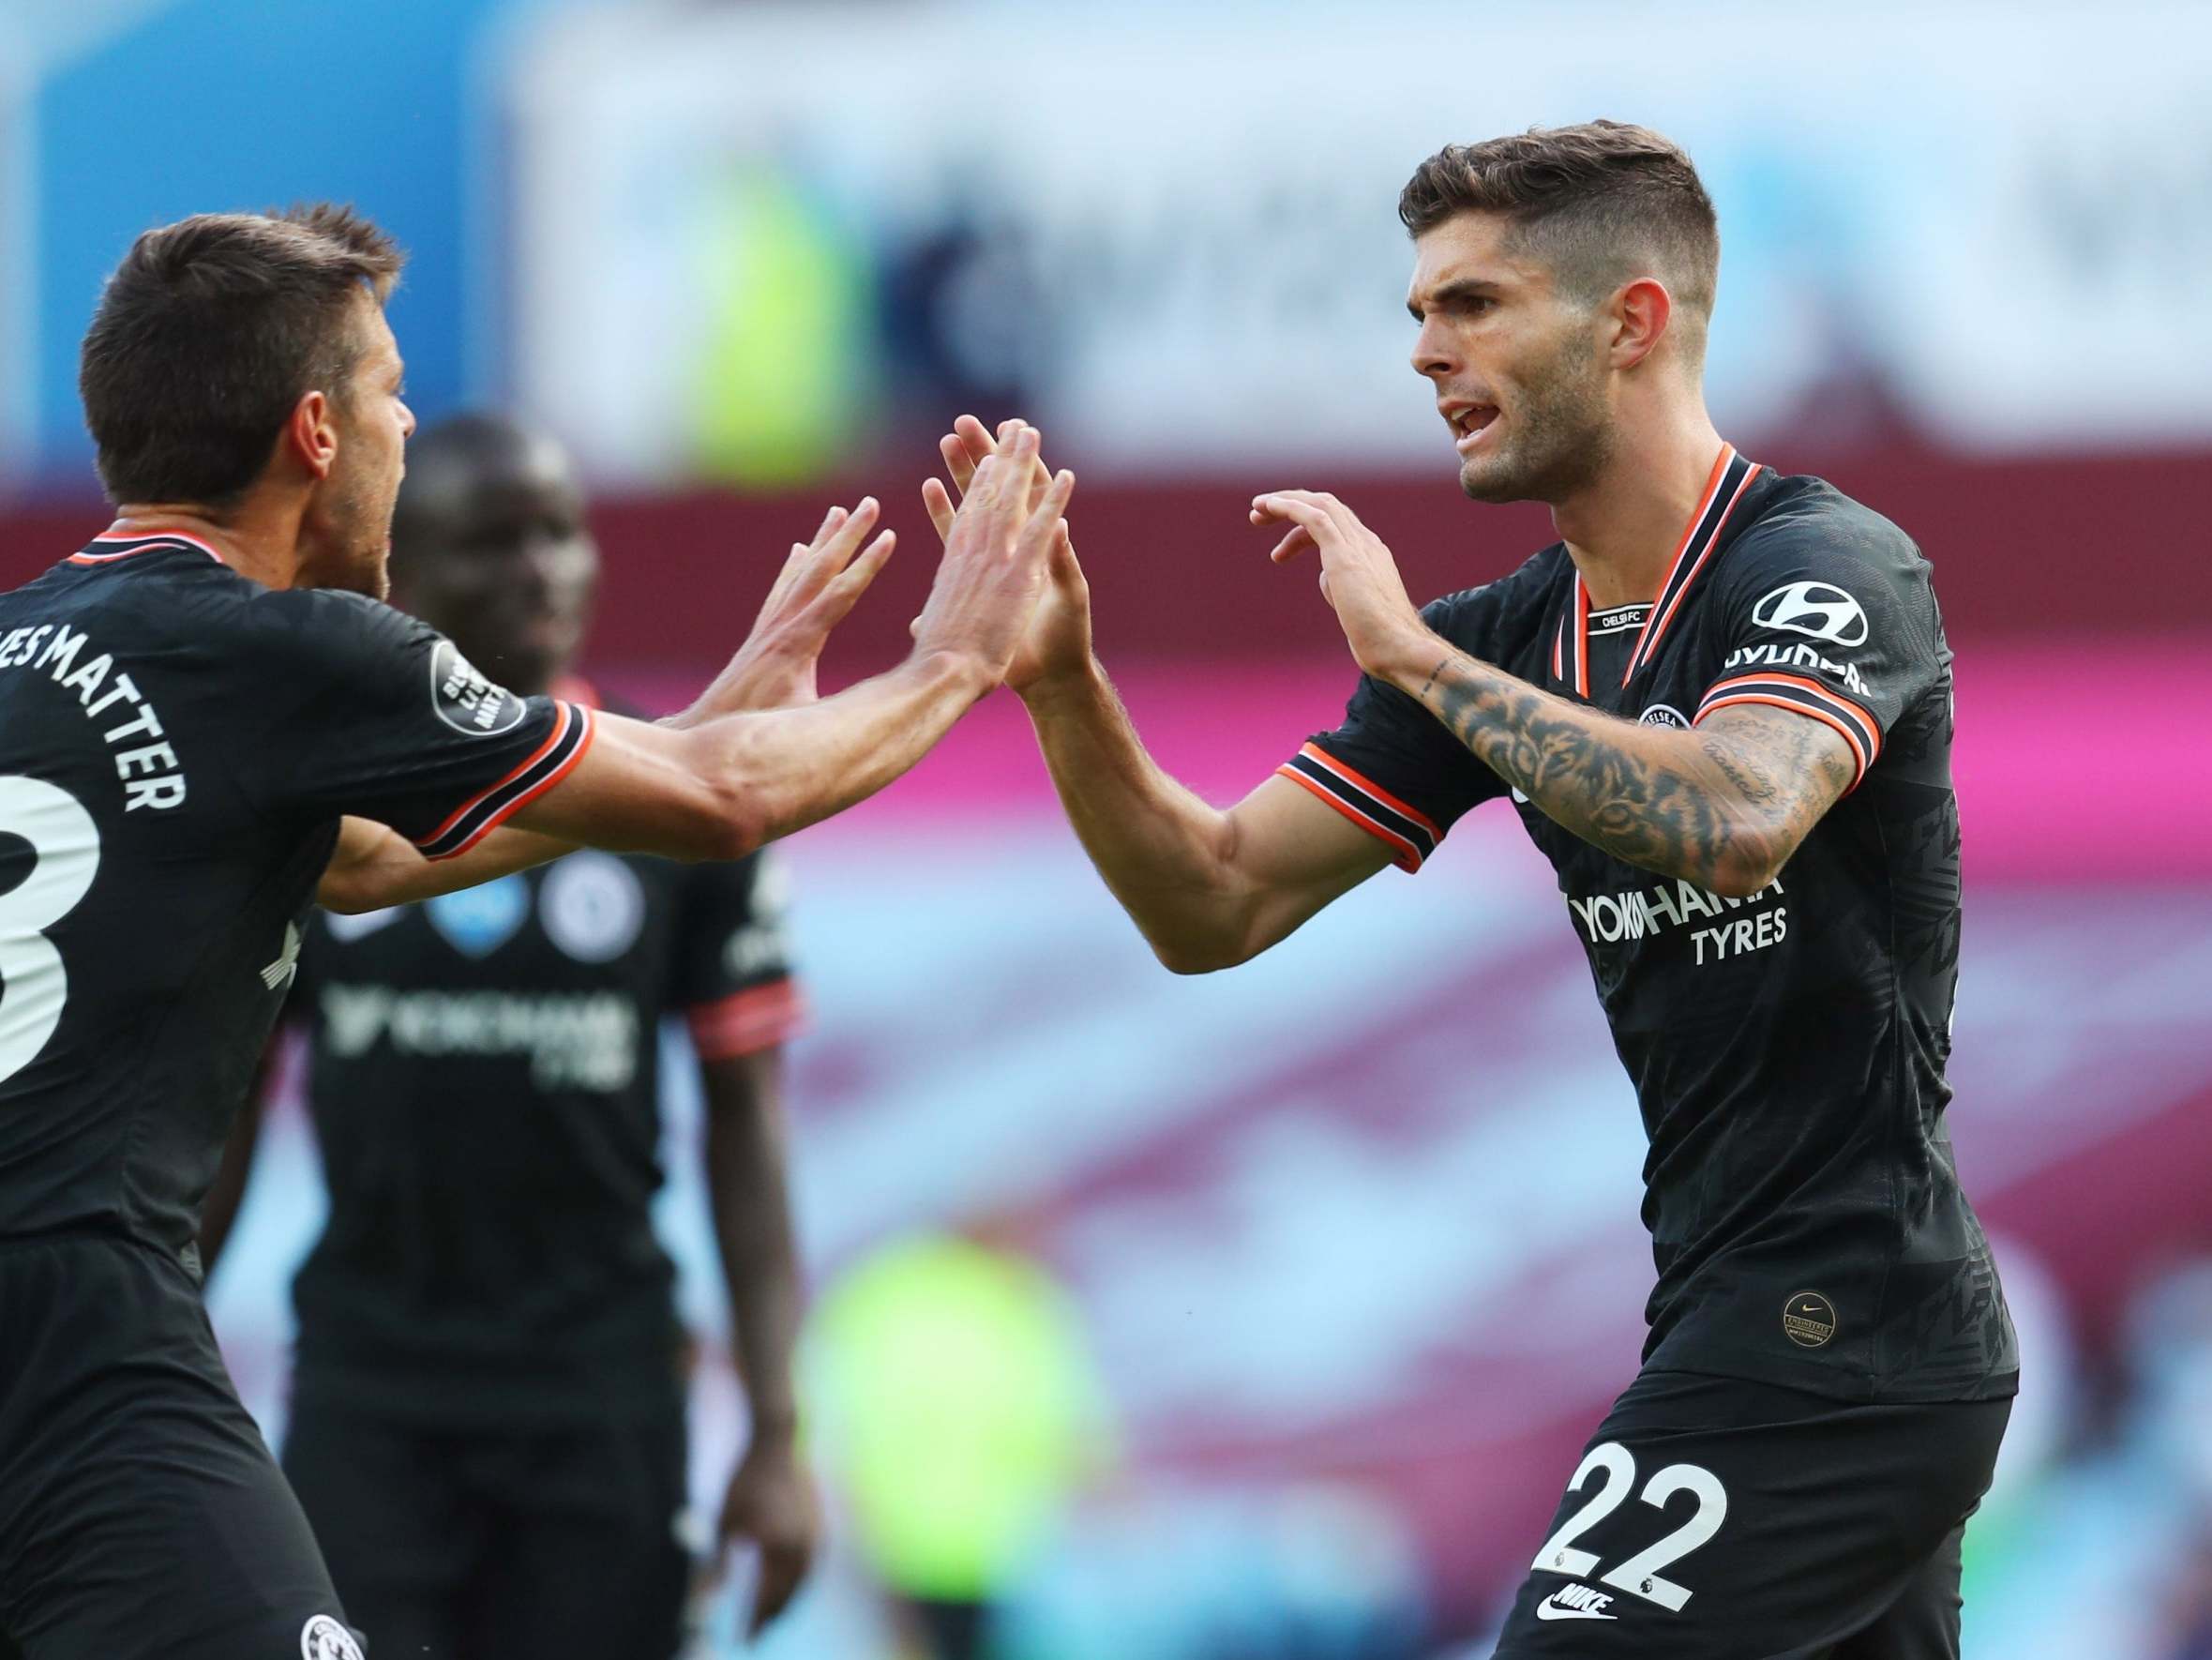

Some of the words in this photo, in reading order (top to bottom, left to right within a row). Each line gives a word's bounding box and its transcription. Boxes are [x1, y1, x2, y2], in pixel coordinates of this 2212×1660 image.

[1628, 611, 1640, 621] FC
[34, 625, 186, 812] MATTER
[1646, 711, 1676, 728] ELSEA
[1691, 907, 1786, 965] TYRES
[1530, 1441, 1727, 1612] 22
[1553, 1583, 1614, 1614] NIKE
